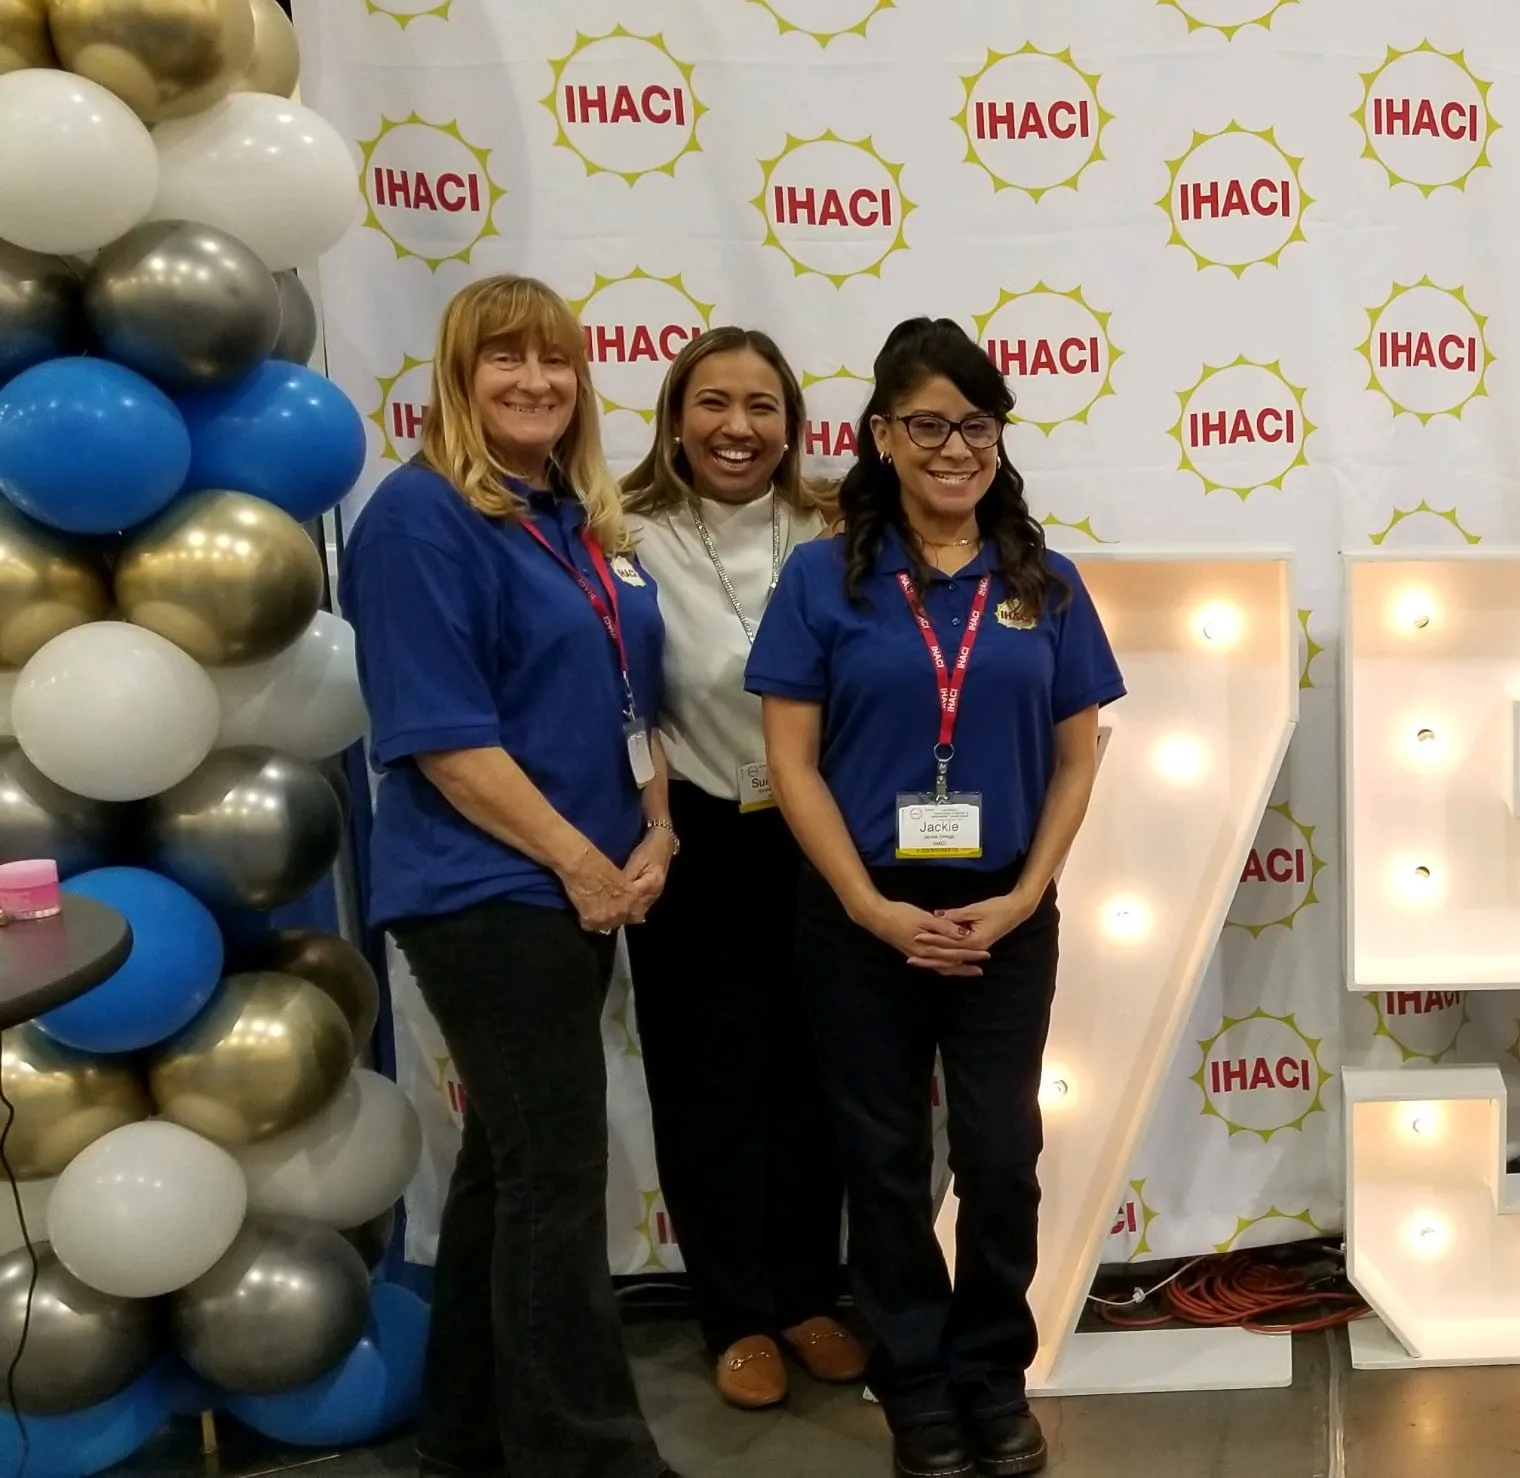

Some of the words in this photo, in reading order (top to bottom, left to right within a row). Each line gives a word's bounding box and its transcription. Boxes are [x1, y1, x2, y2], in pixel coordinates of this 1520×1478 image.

[565, 85, 685, 125] IHACI
[975, 100, 1089, 140] IHACI
[1374, 98, 1478, 141] IHACI
[375, 167, 480, 212] IHACI
[774, 186, 892, 227] IHACI
[1180, 178, 1291, 221] IHACI
[1378, 331, 1477, 372] IHACI
[1190, 407, 1295, 447] IHACI
[931, 646, 945, 668] IHACI
[957, 647, 970, 669] IHACI
[947, 689, 958, 712] IHACI
[920, 822, 959, 833] Jackie
[1240, 848, 1304, 883] ACI
[1212, 1057, 1310, 1093] IHACI
